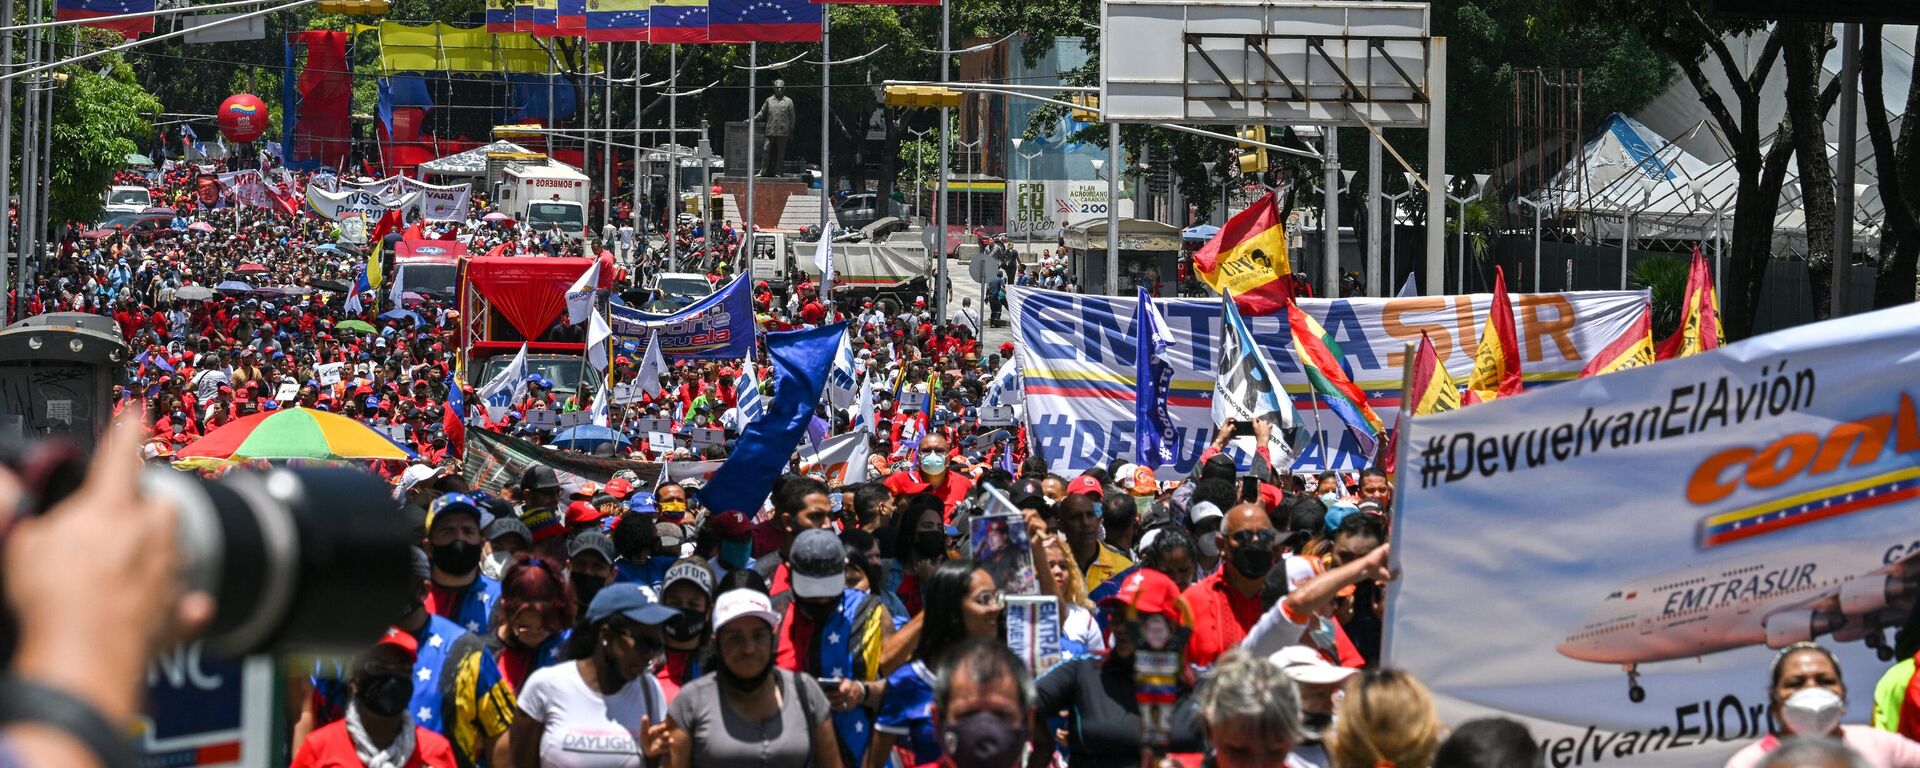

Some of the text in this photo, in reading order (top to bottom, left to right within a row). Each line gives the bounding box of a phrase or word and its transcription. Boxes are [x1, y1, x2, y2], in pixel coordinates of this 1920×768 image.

[1020, 293, 1583, 374] EMTRASUR
[1421, 358, 1816, 489] #DevuelvanElAvión
[1662, 562, 1817, 616] EMTRASUR
